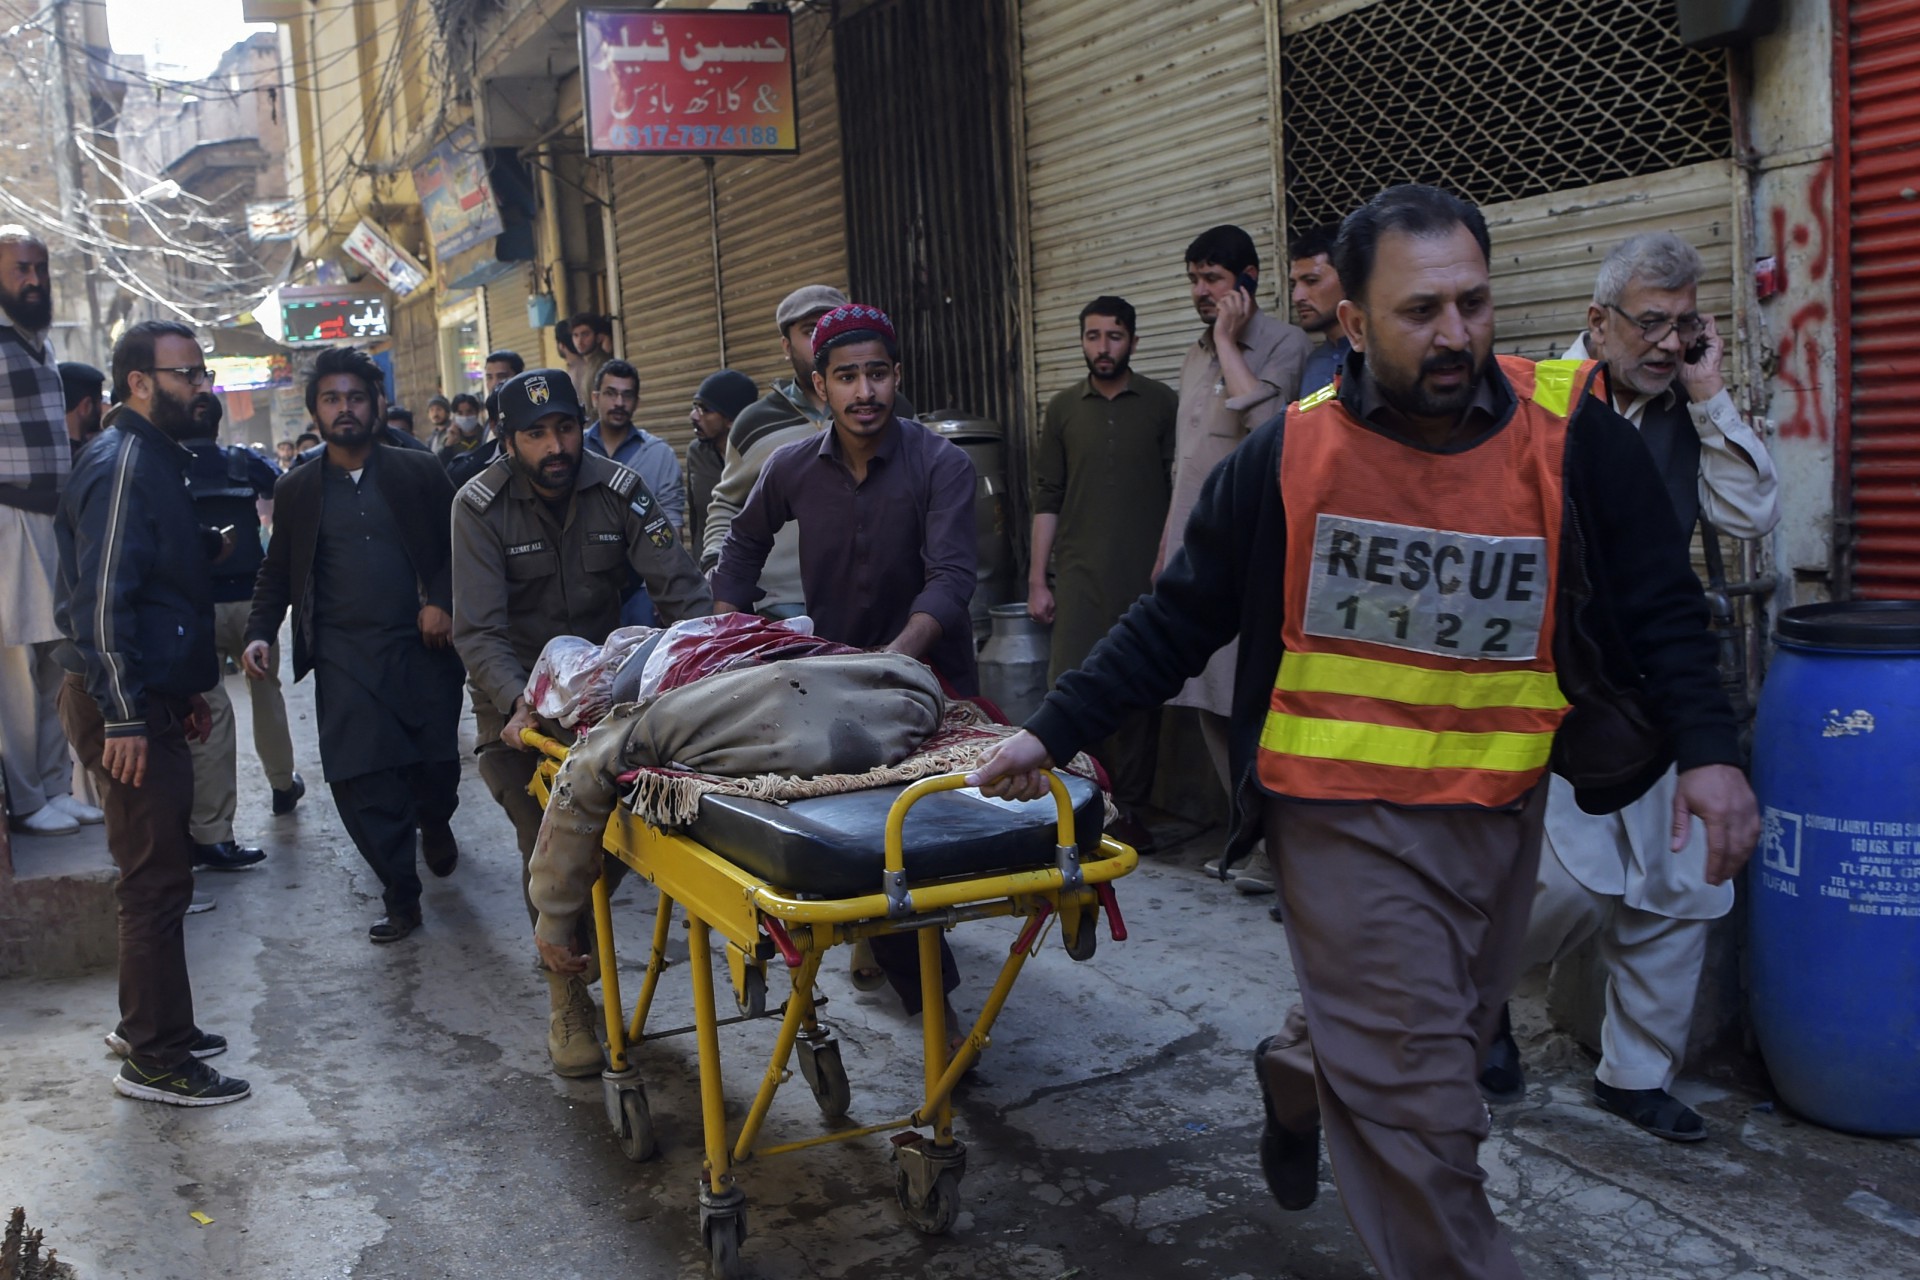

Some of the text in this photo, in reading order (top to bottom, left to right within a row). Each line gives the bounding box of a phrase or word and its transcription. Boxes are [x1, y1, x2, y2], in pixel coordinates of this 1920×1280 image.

[680, 31, 787, 74] حسین
[610, 125, 779, 146] 0317-7974188
[1326, 528, 1537, 602] RESCUE
[1893, 841, 1911, 855] NET
[1839, 861, 1896, 878] TUFAIL
[1761, 871, 1800, 897] TUFAIL
[1830, 875, 1847, 887] TEL
[1849, 903, 1878, 915] MADE
